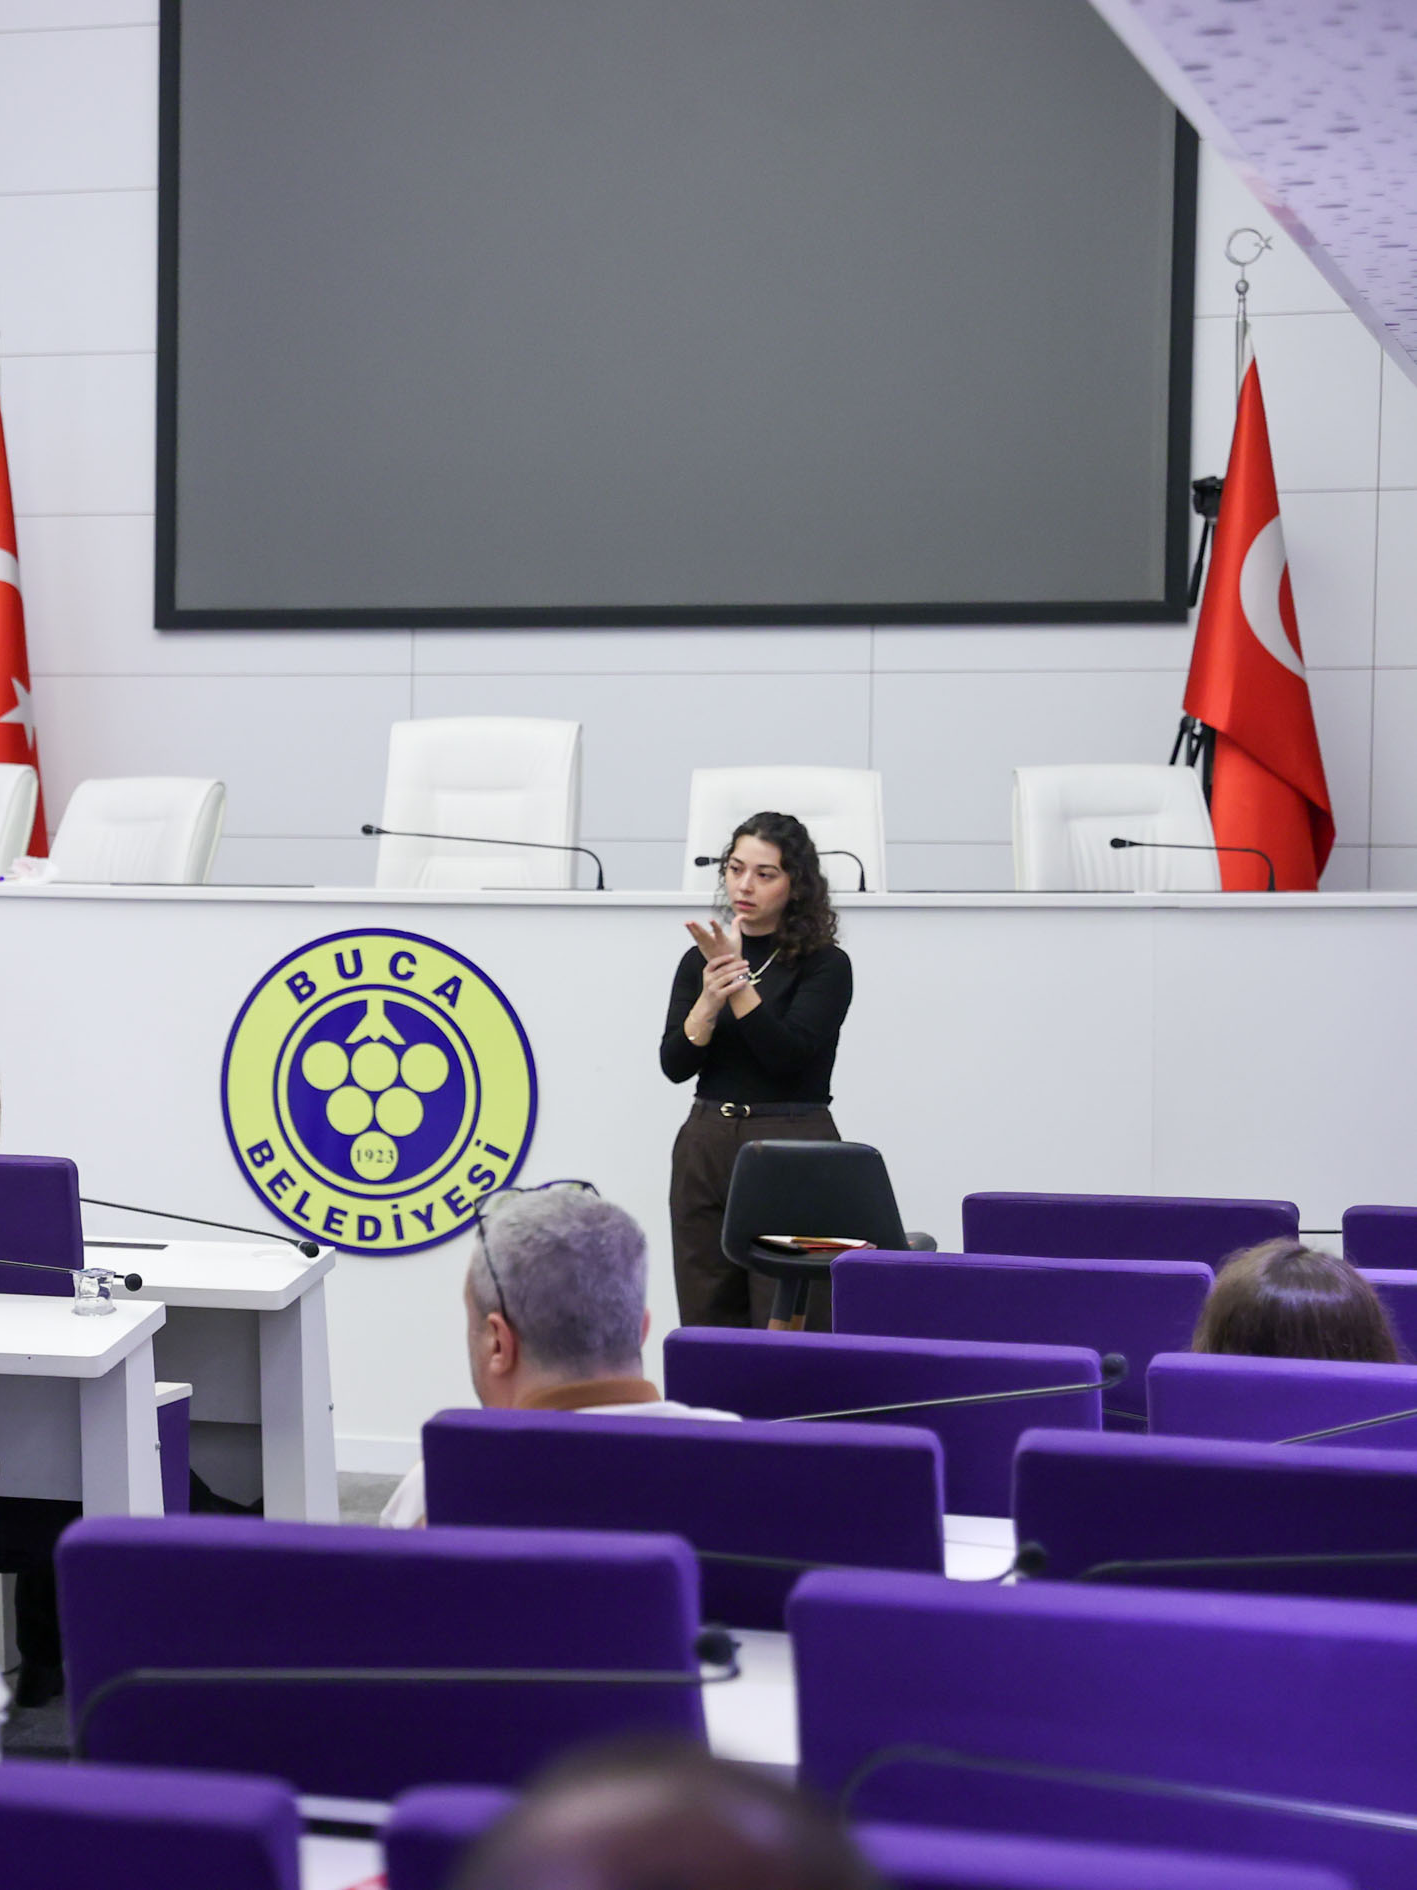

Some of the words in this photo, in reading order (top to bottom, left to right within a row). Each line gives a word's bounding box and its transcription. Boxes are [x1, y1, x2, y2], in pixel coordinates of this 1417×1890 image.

[285, 948, 463, 1009] BUCA
[355, 1150, 395, 1164] 1923
[246, 1139, 510, 1242] BELEDİYESİ
